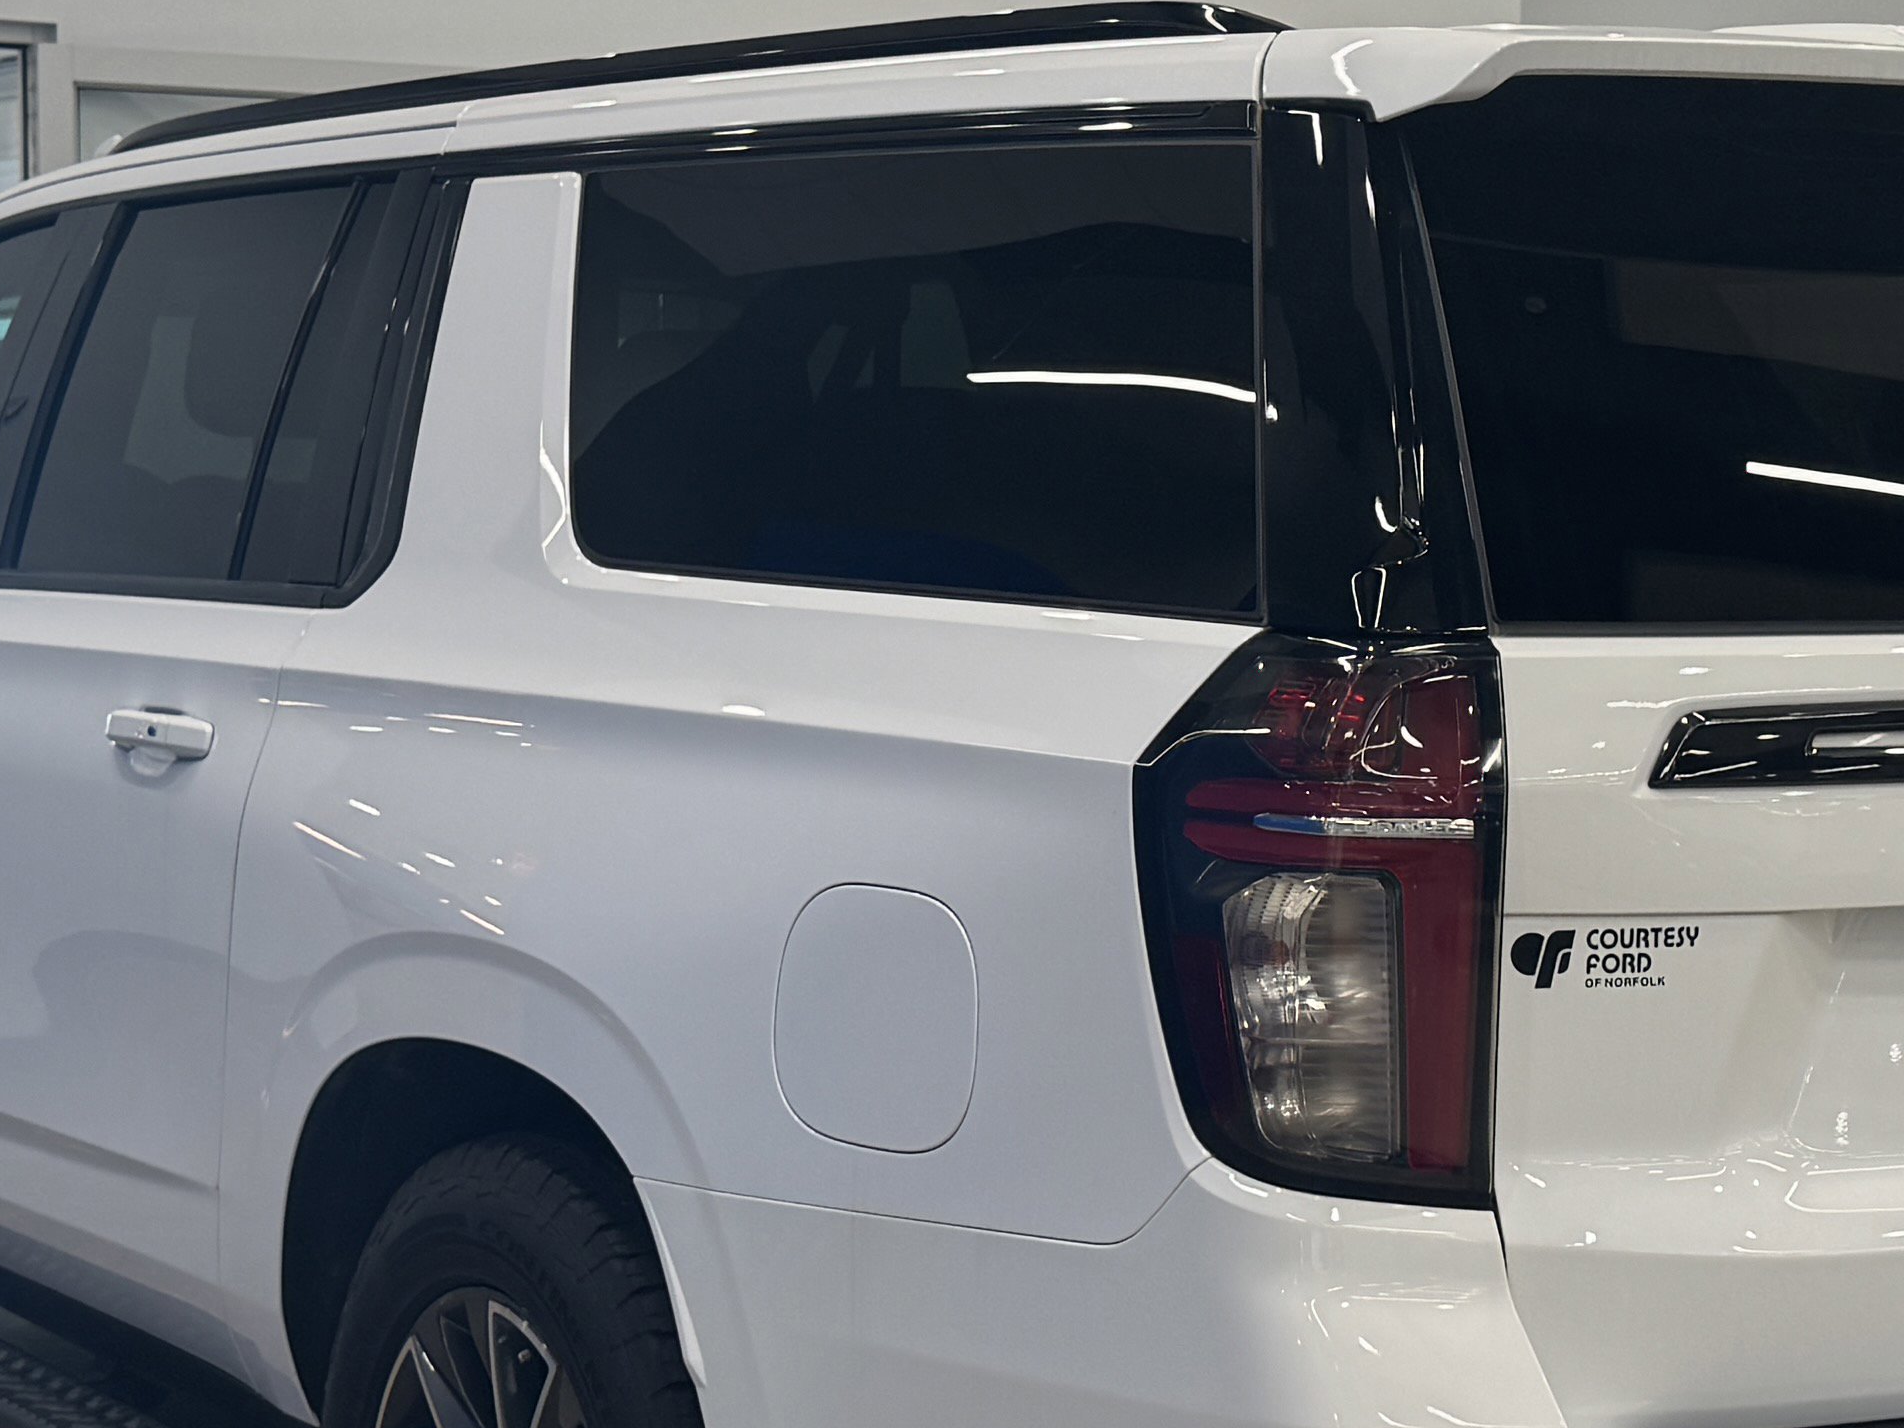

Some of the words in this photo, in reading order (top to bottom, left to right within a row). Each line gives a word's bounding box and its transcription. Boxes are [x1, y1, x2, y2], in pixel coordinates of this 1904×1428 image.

[1586, 925, 1700, 950] COURTESY
[1585, 952, 1652, 975] FORD
[1584, 977, 1602, 989] OF
[1604, 975, 1666, 988] NORFOLK
